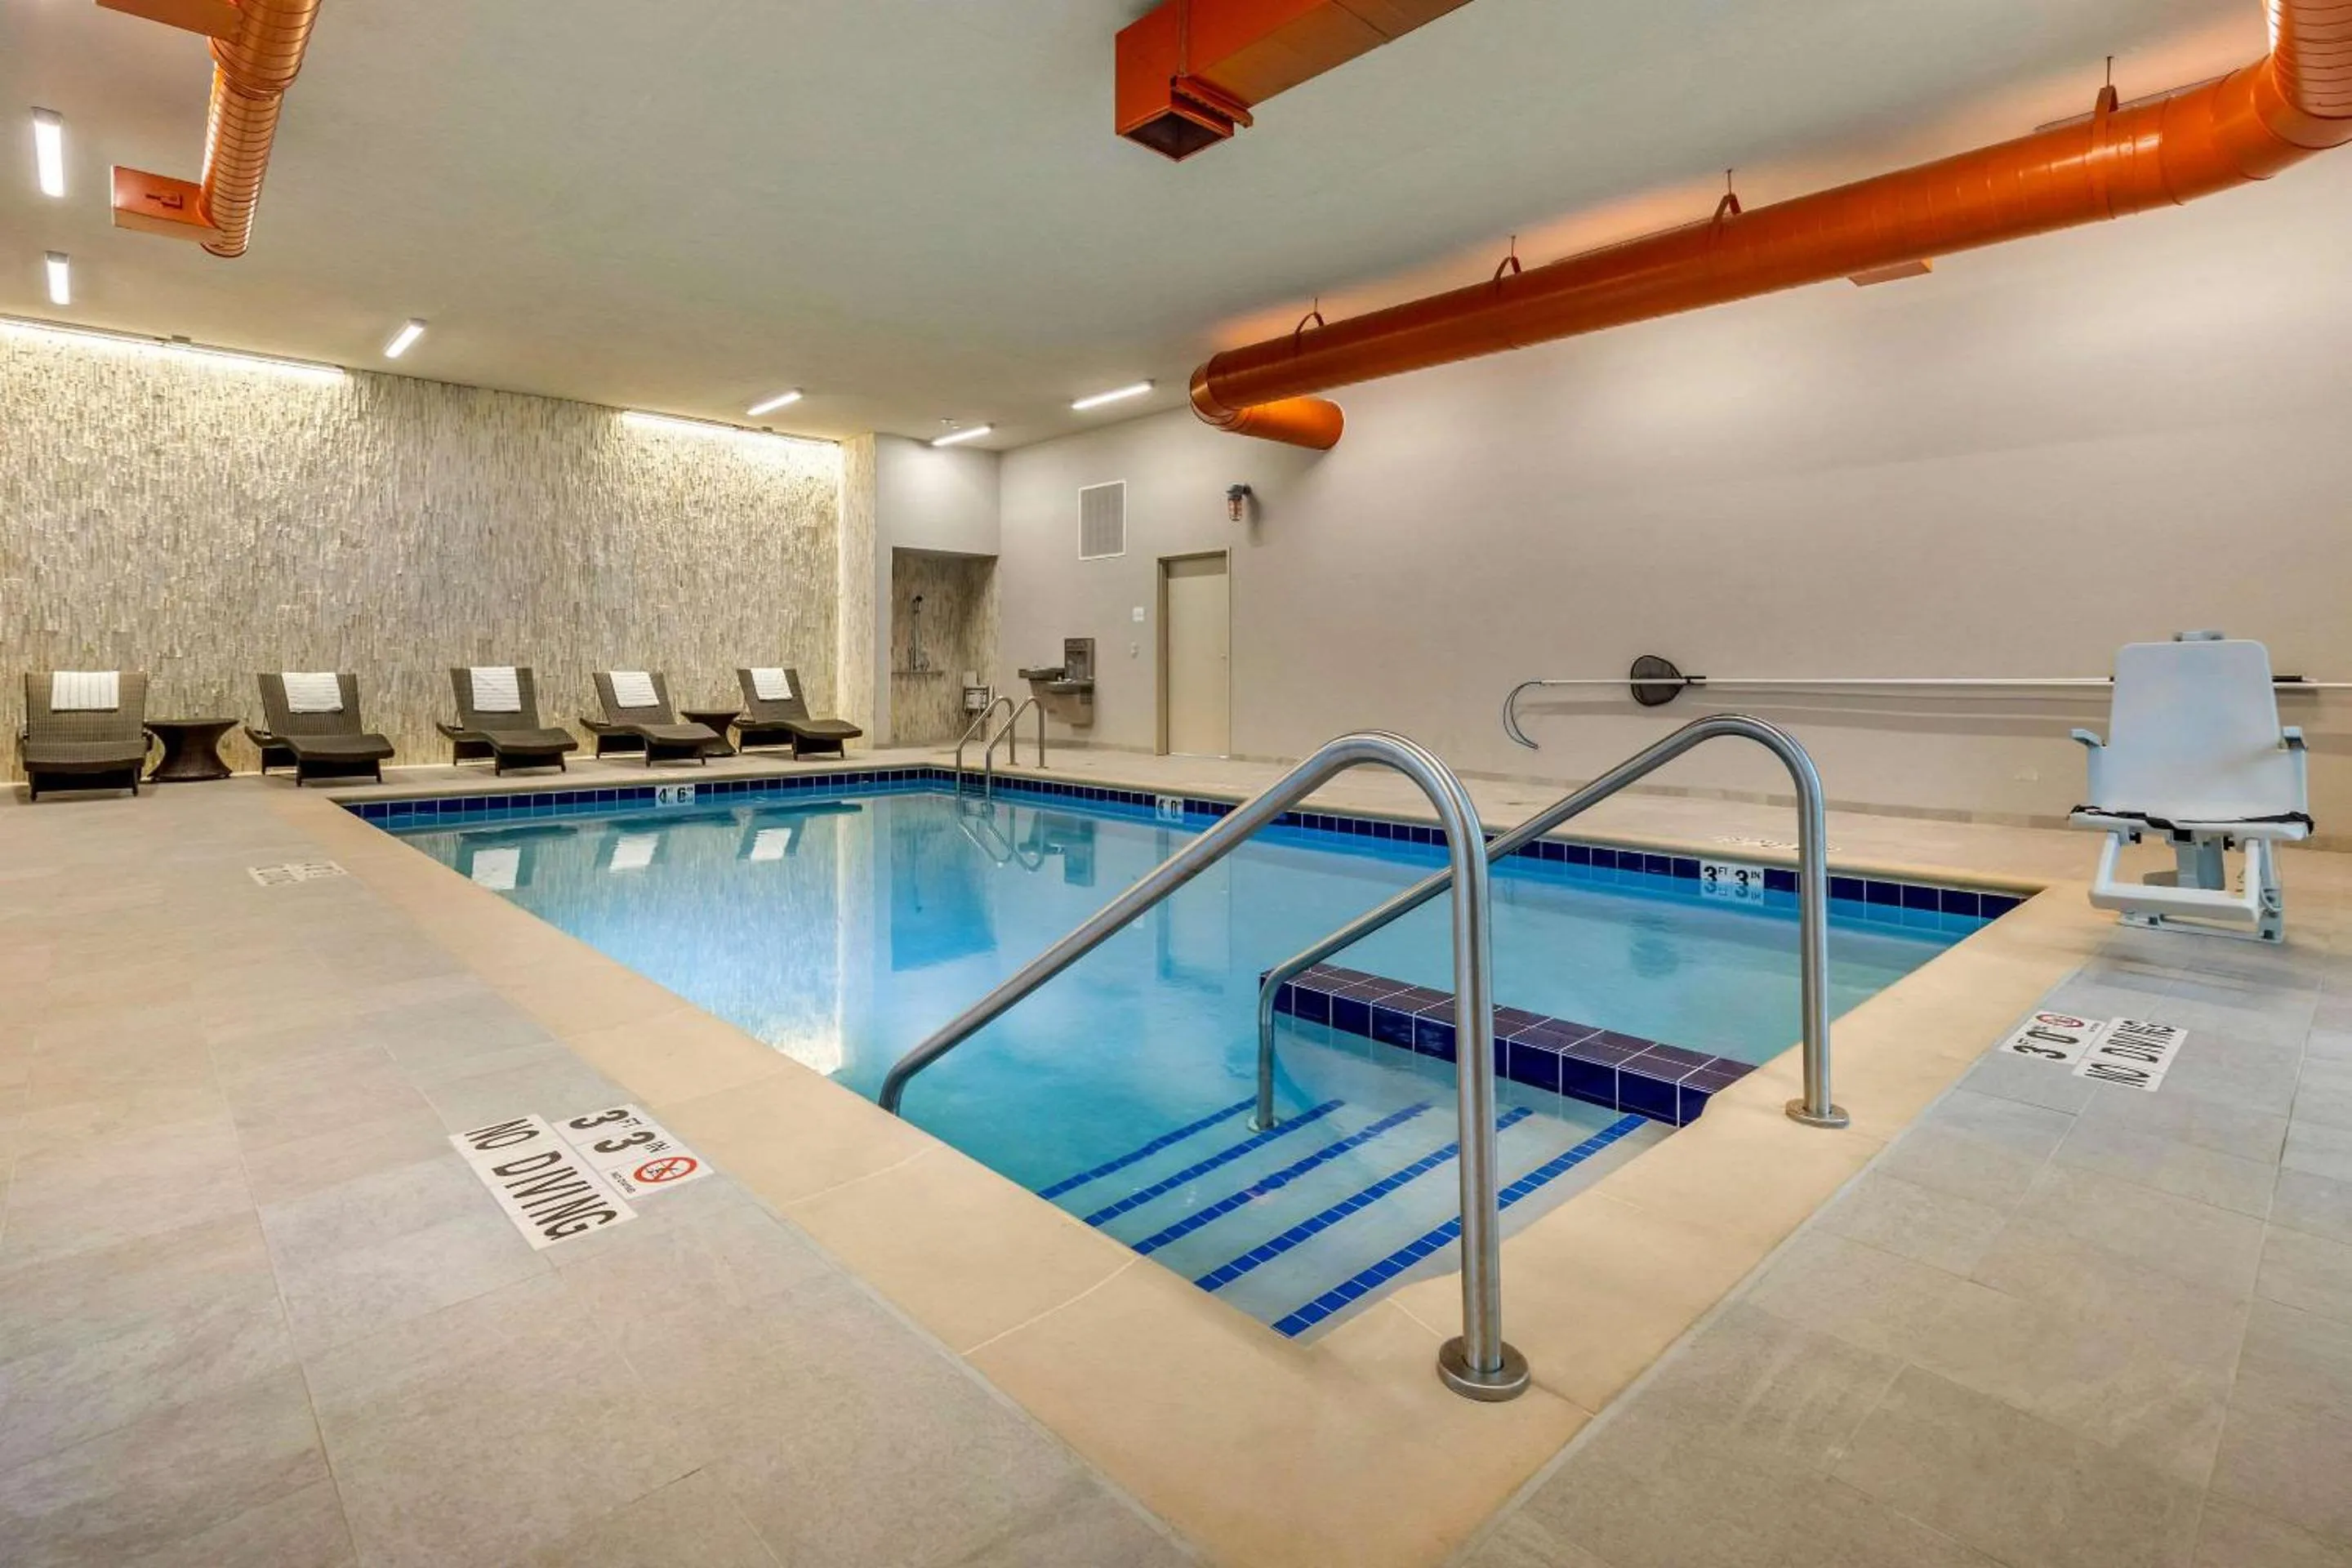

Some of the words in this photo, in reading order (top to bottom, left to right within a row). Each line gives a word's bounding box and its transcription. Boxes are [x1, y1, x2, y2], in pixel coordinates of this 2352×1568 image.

[2084, 1062, 2151, 1088] NO
[569, 1109, 629, 1129] 3
[464, 1119, 540, 1151] NO
[594, 1131, 657, 1153] 3
[492, 1151, 617, 1241] DIVING
